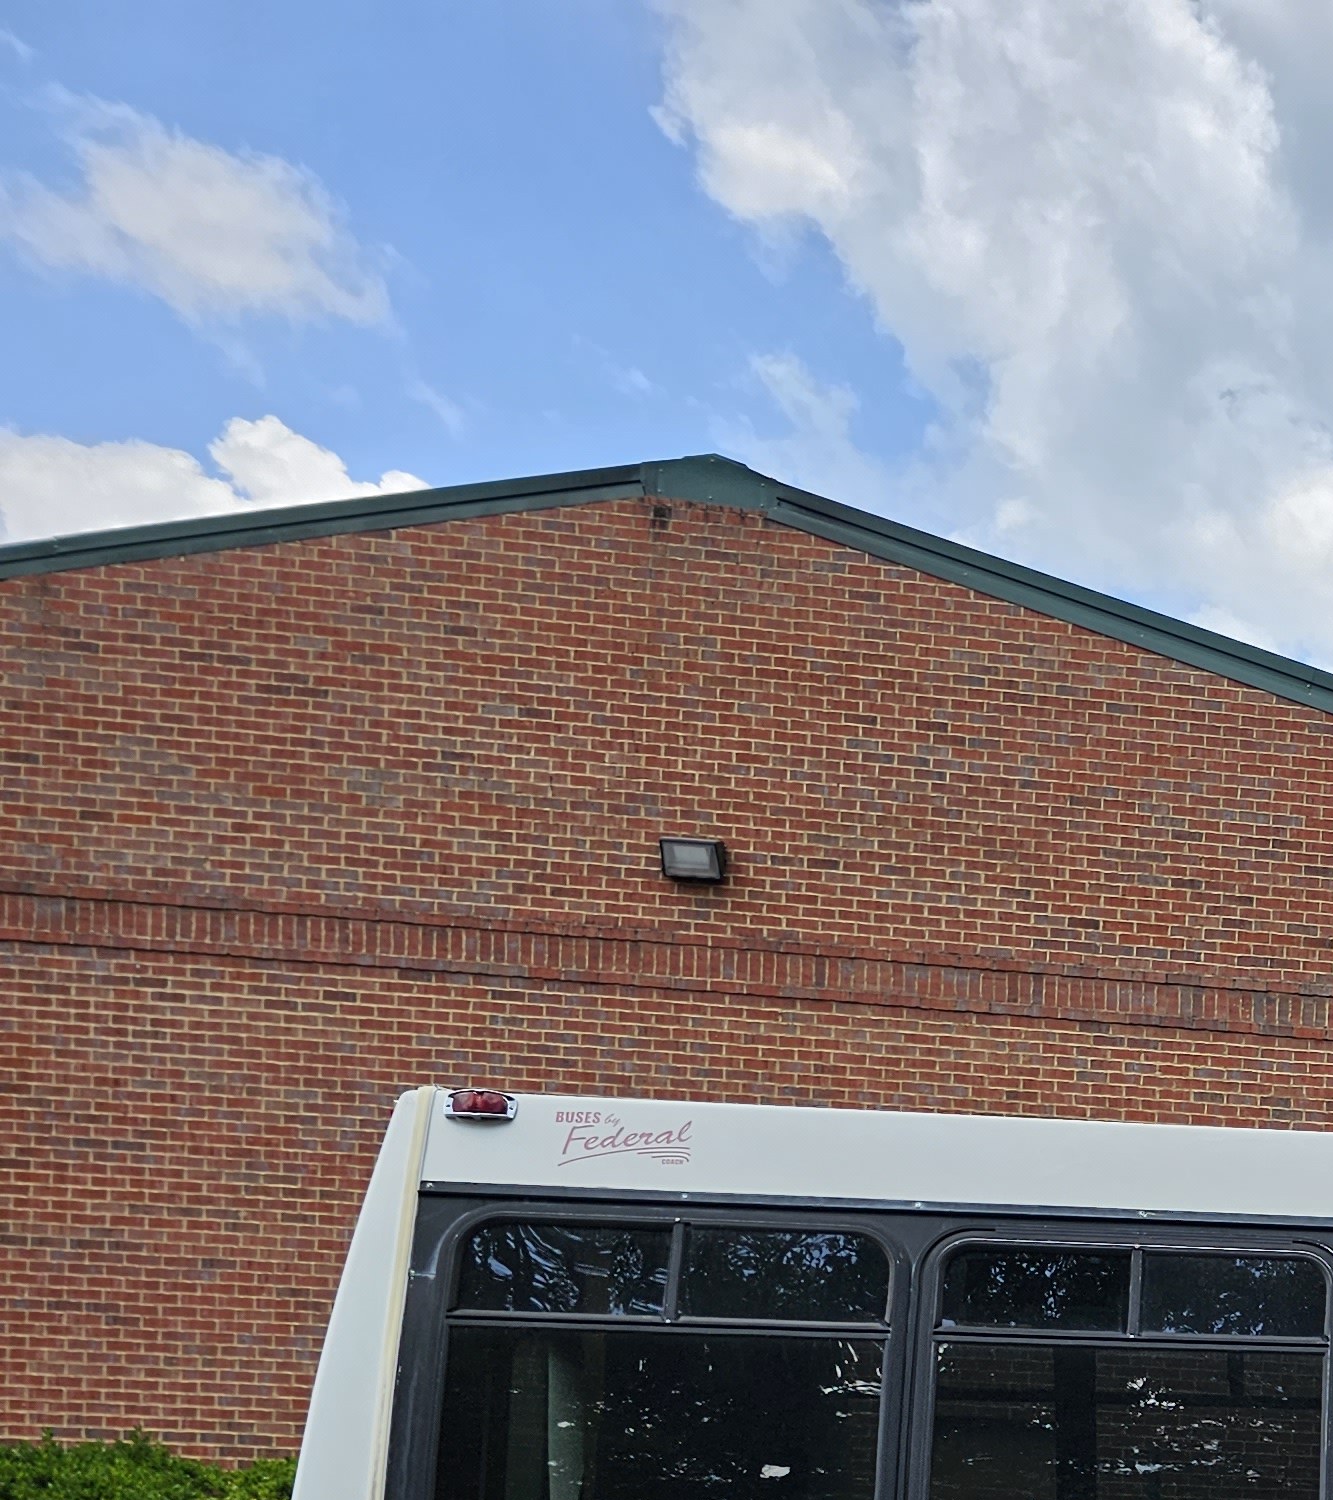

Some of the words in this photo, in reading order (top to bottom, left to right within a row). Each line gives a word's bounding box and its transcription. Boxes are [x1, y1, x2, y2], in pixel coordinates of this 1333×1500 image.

[555, 1111, 602, 1124] BUSES
[604, 1113, 621, 1127] by
[562, 1120, 693, 1155] Federal
